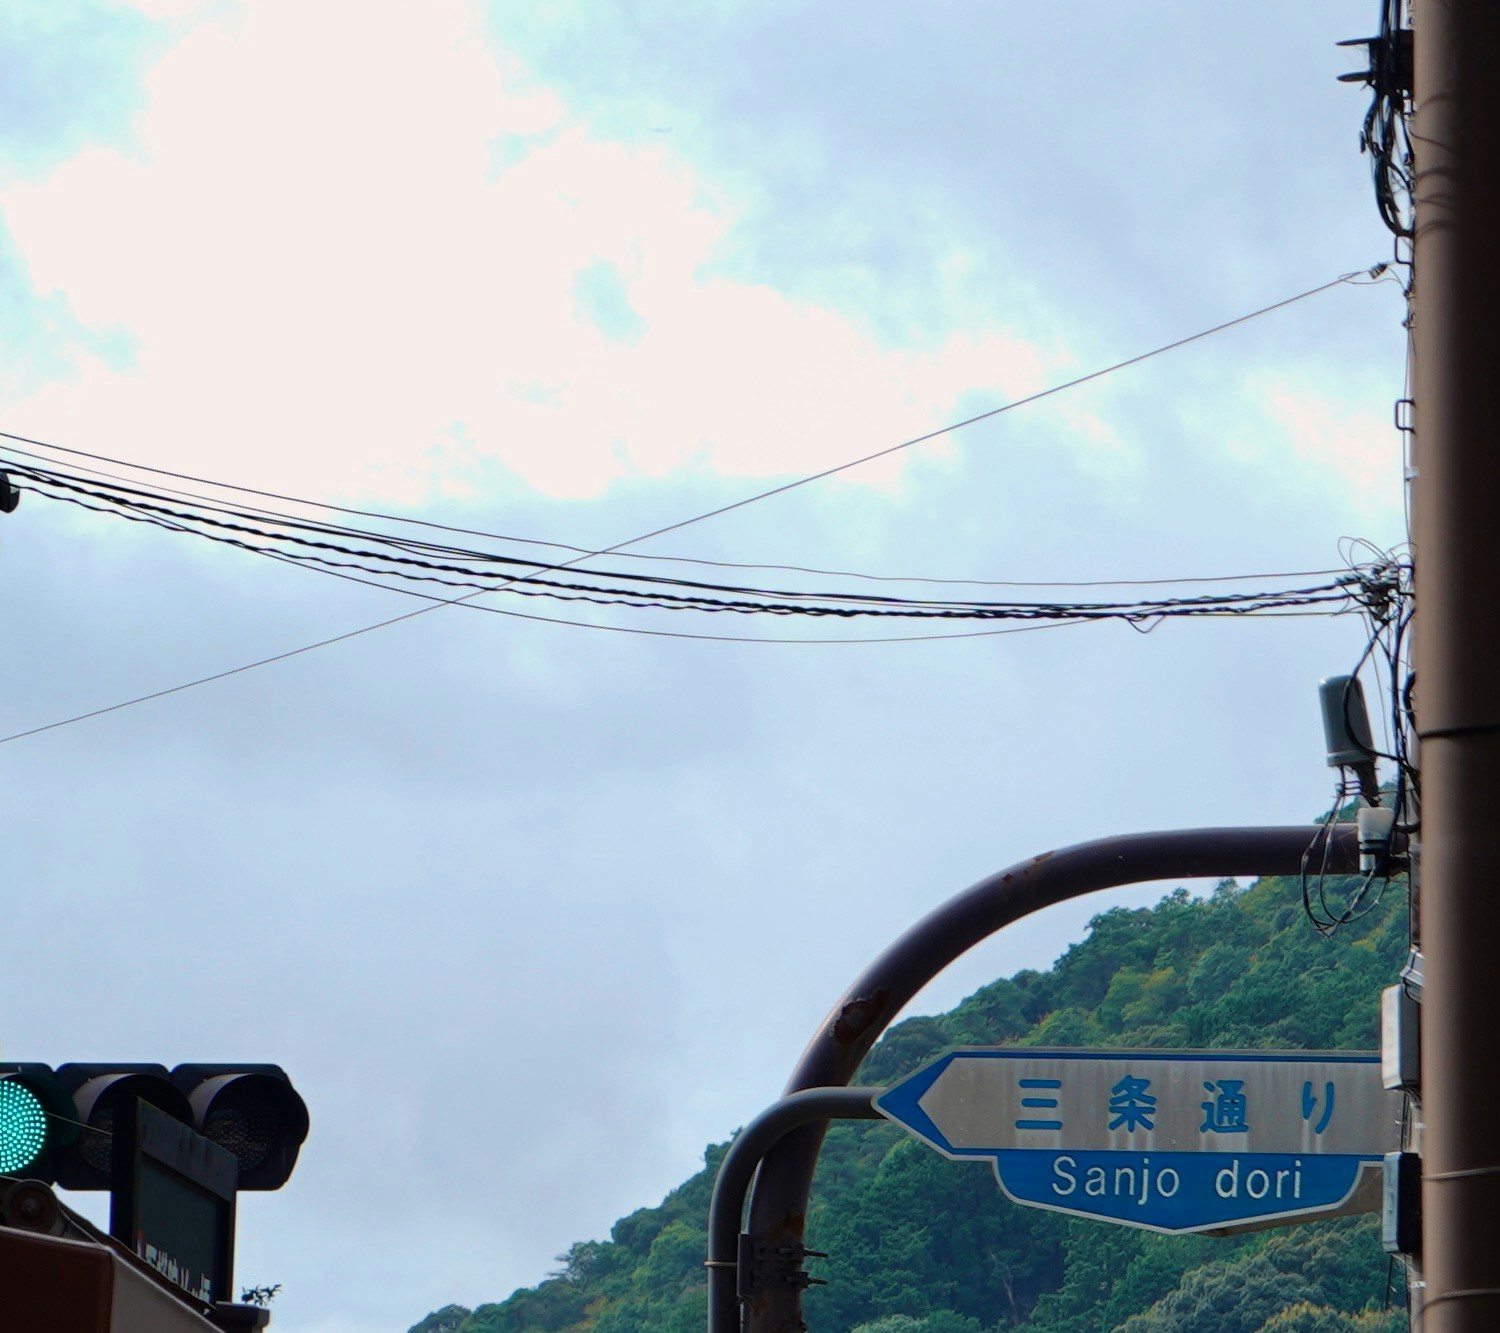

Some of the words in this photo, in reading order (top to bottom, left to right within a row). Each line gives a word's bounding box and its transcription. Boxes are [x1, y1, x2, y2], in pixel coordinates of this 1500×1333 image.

[1014, 1073, 1336, 1135] 三条通り
[1051, 1156, 1180, 1206] Sanjo
[1214, 1158, 1302, 1199] dori
